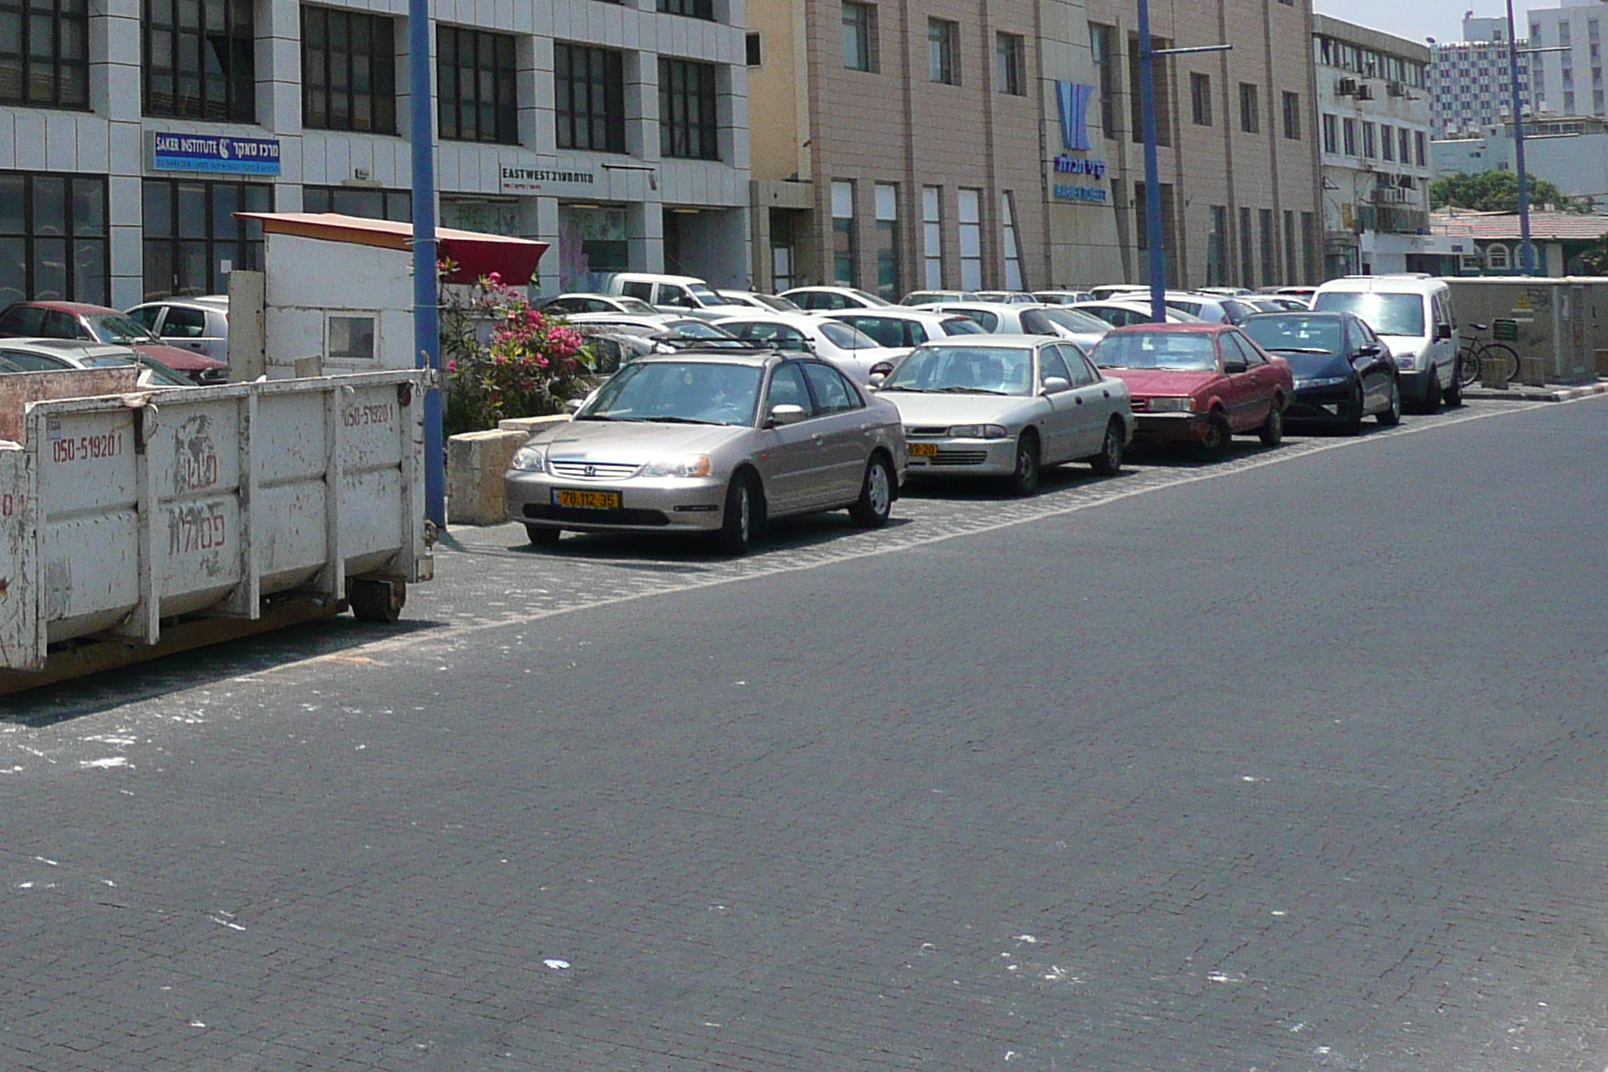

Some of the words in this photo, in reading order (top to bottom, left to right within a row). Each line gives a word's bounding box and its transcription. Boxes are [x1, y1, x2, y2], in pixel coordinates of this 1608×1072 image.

[156, 136, 180, 151] SAKER
[181, 138, 218, 154] INSTITUTE
[233, 141, 257, 159] סאקר
[259, 143, 279, 157] מרכז
